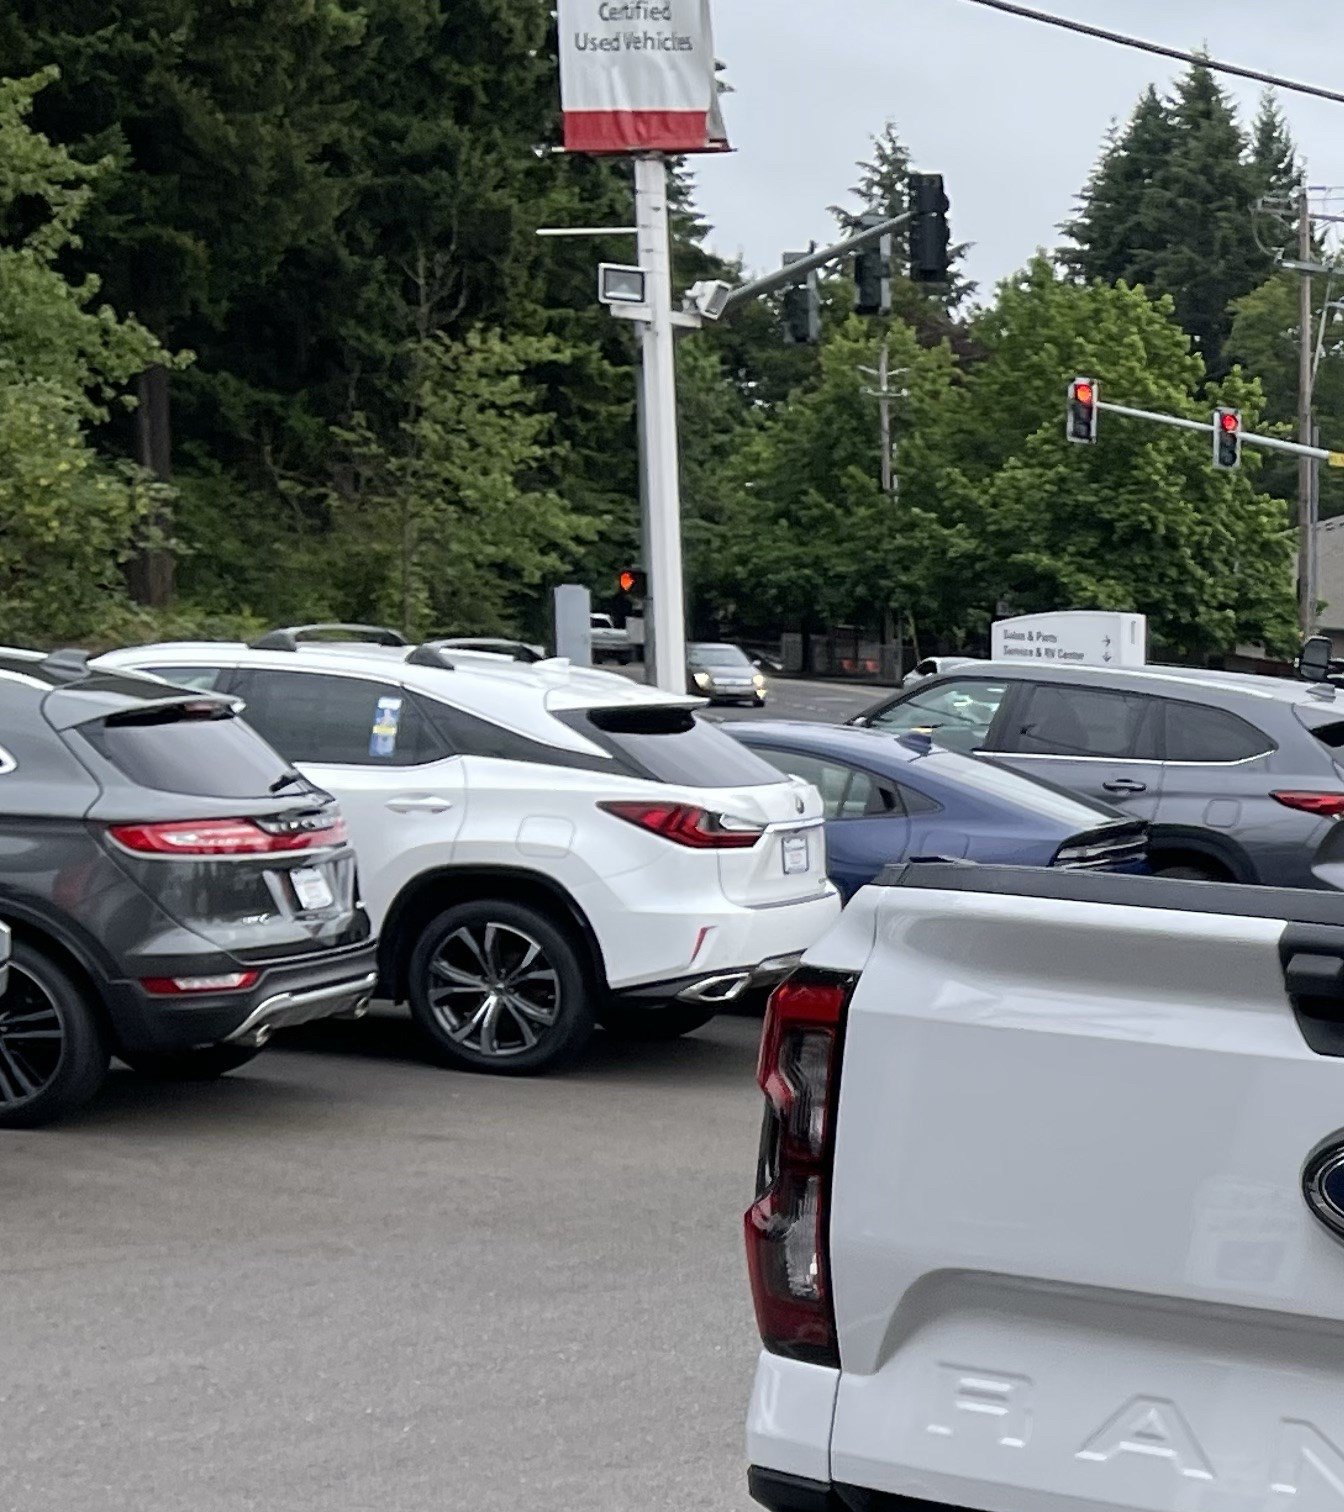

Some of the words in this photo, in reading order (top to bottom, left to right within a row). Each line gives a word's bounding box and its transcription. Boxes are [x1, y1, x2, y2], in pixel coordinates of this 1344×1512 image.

[598, 0, 671, 21] Certified
[574, 32, 620, 51] Used
[622, 30, 693, 51] Vehicles
